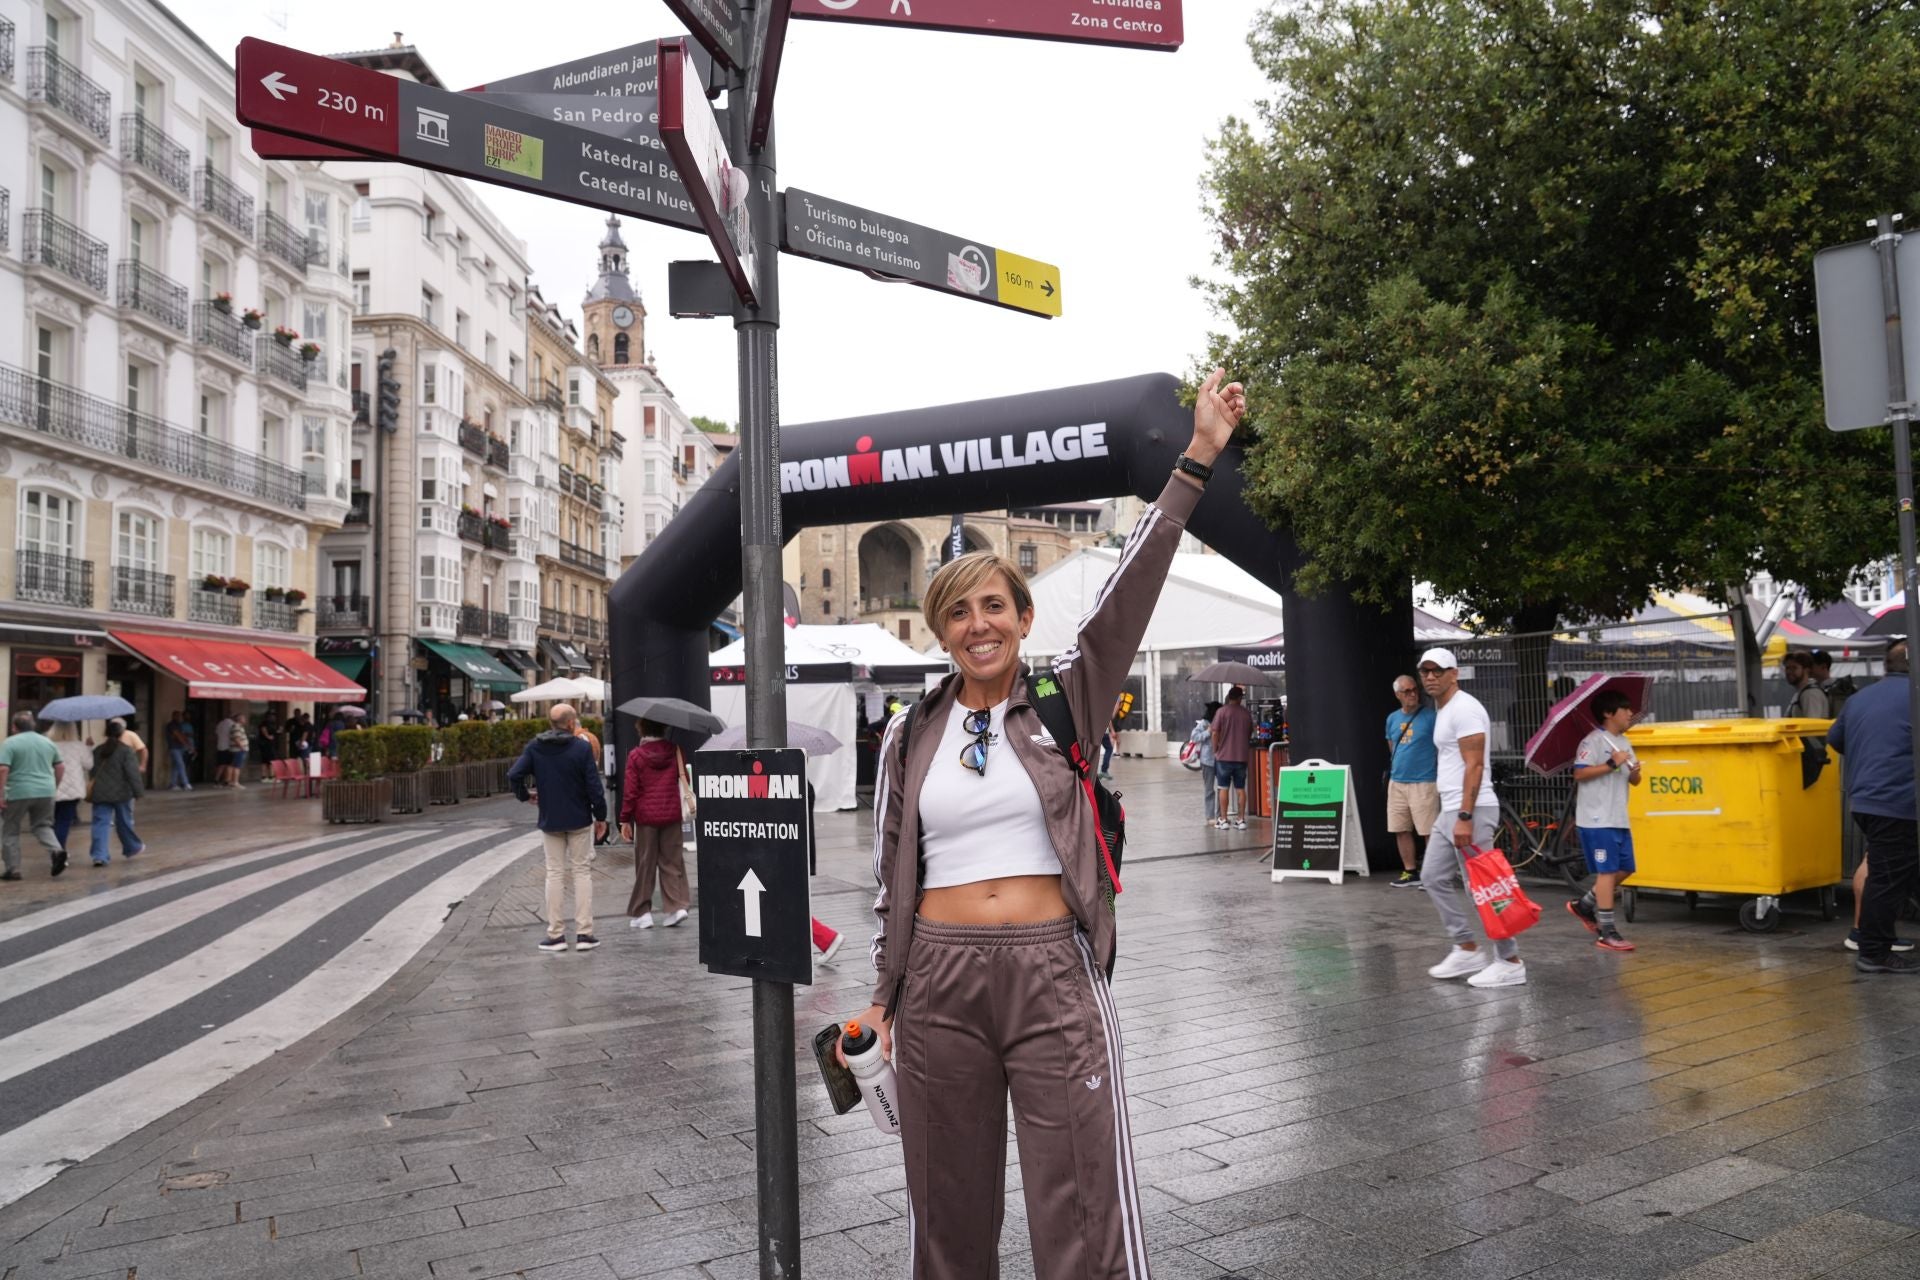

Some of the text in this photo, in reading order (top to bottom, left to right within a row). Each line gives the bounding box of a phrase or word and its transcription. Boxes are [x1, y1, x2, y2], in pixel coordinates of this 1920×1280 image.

[1071, 12, 1163, 33] Zona Centro
[553, 54, 658, 90] Aldundiaren jaur
[625, 76, 658, 95] Provi
[317, 88, 384, 122] 230 m
[553, 107, 659, 123] San Pedro e
[486, 125, 522, 144] MAKRO
[581, 142, 683, 184] Katedral Be
[579, 171, 696, 214] Catedral Nuev
[805, 203, 909, 245] Turismo bulegoa
[806, 228, 921, 271] Oficina de Turismo
[1005, 271, 1034, 289] 160 m
[780, 422, 1109, 494] RONMAN VILLAGE
[1247, 651, 1285, 666] mastric
[1453, 645, 1502, 661] tion.com
[698, 761, 801, 800] IRONMAN
[703, 821, 799, 840] REGISTRATION
[873, 1084, 899, 1128] NDURANZ
